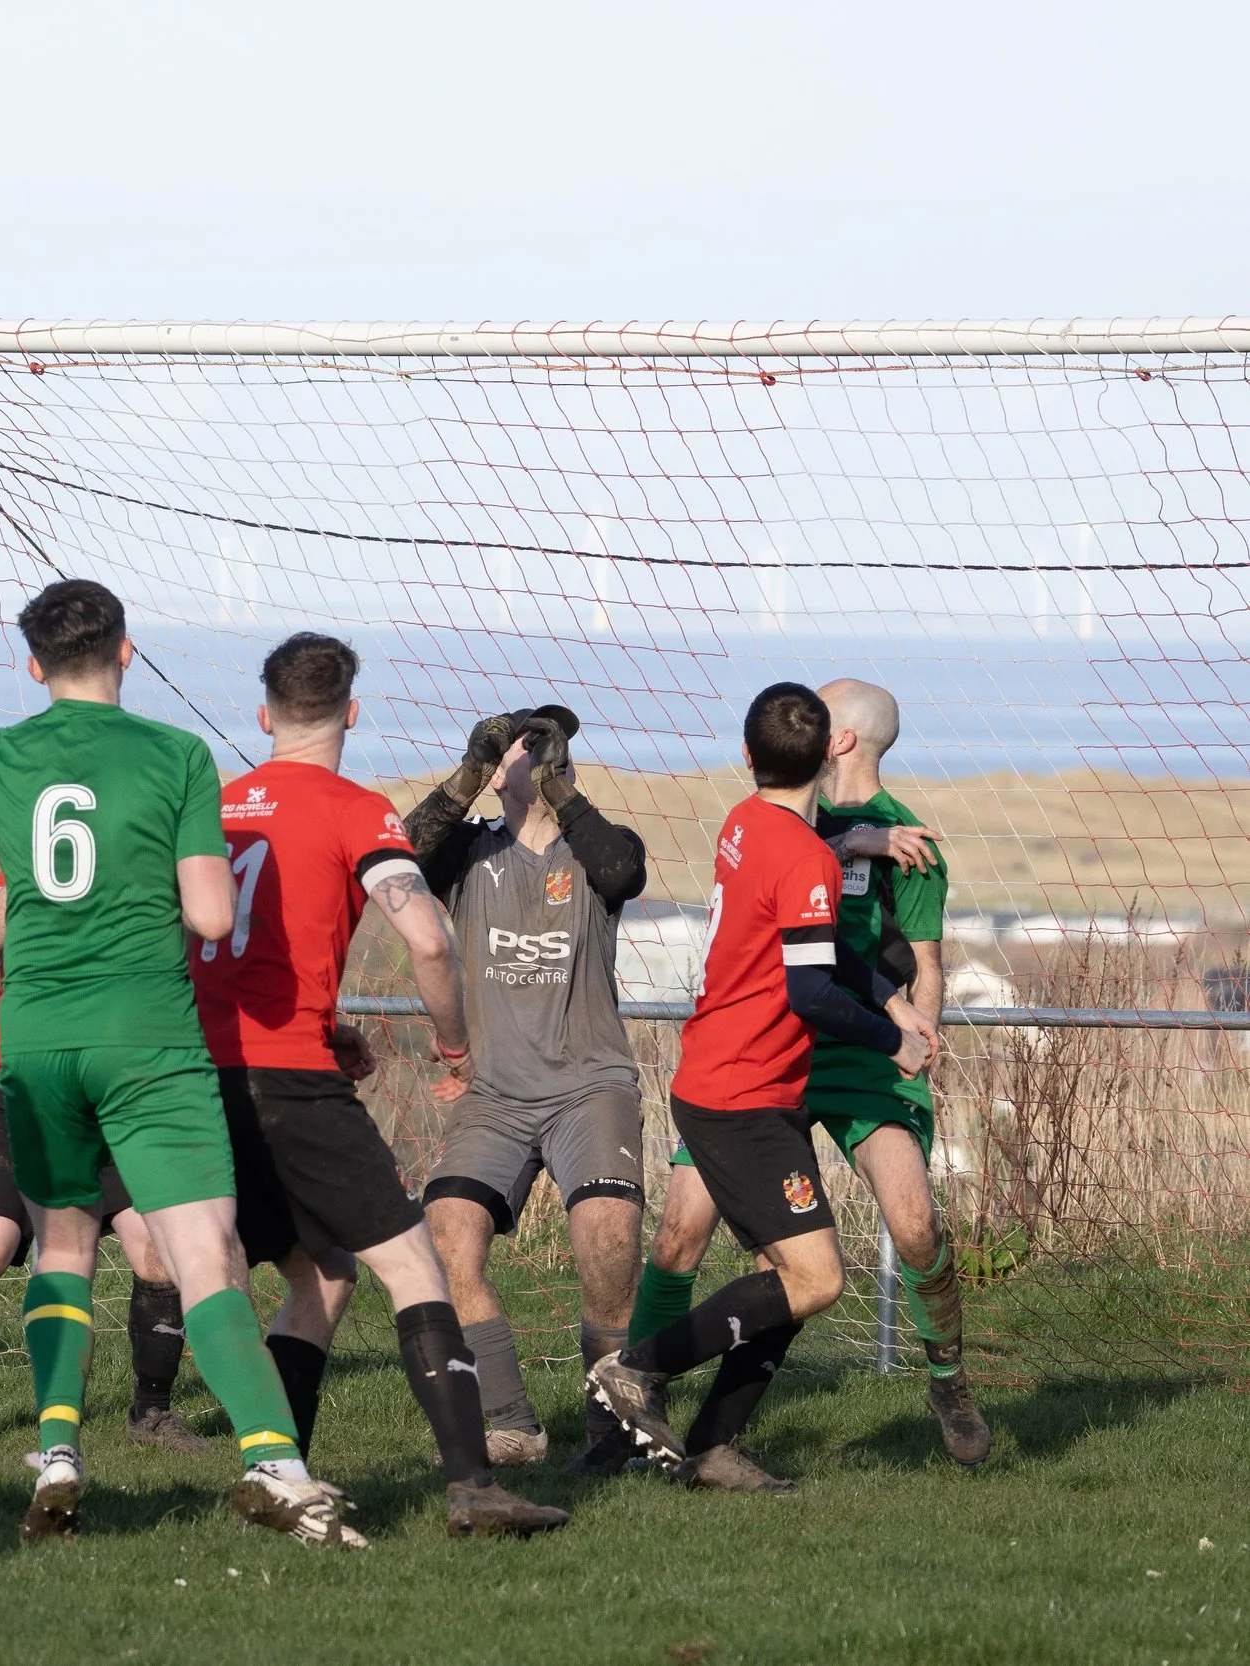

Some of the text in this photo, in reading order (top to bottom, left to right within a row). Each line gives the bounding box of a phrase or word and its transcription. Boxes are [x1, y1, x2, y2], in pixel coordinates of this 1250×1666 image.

[236, 801, 279, 811] HOWELLS
[32, 784, 97, 902] 6
[842, 870, 866, 882] ahs
[200, 839, 269, 963] 1
[488, 926, 571, 963] PSS
[485, 966, 568, 985] AUTO CENTRE
[598, 1177, 637, 1190] Sondico
